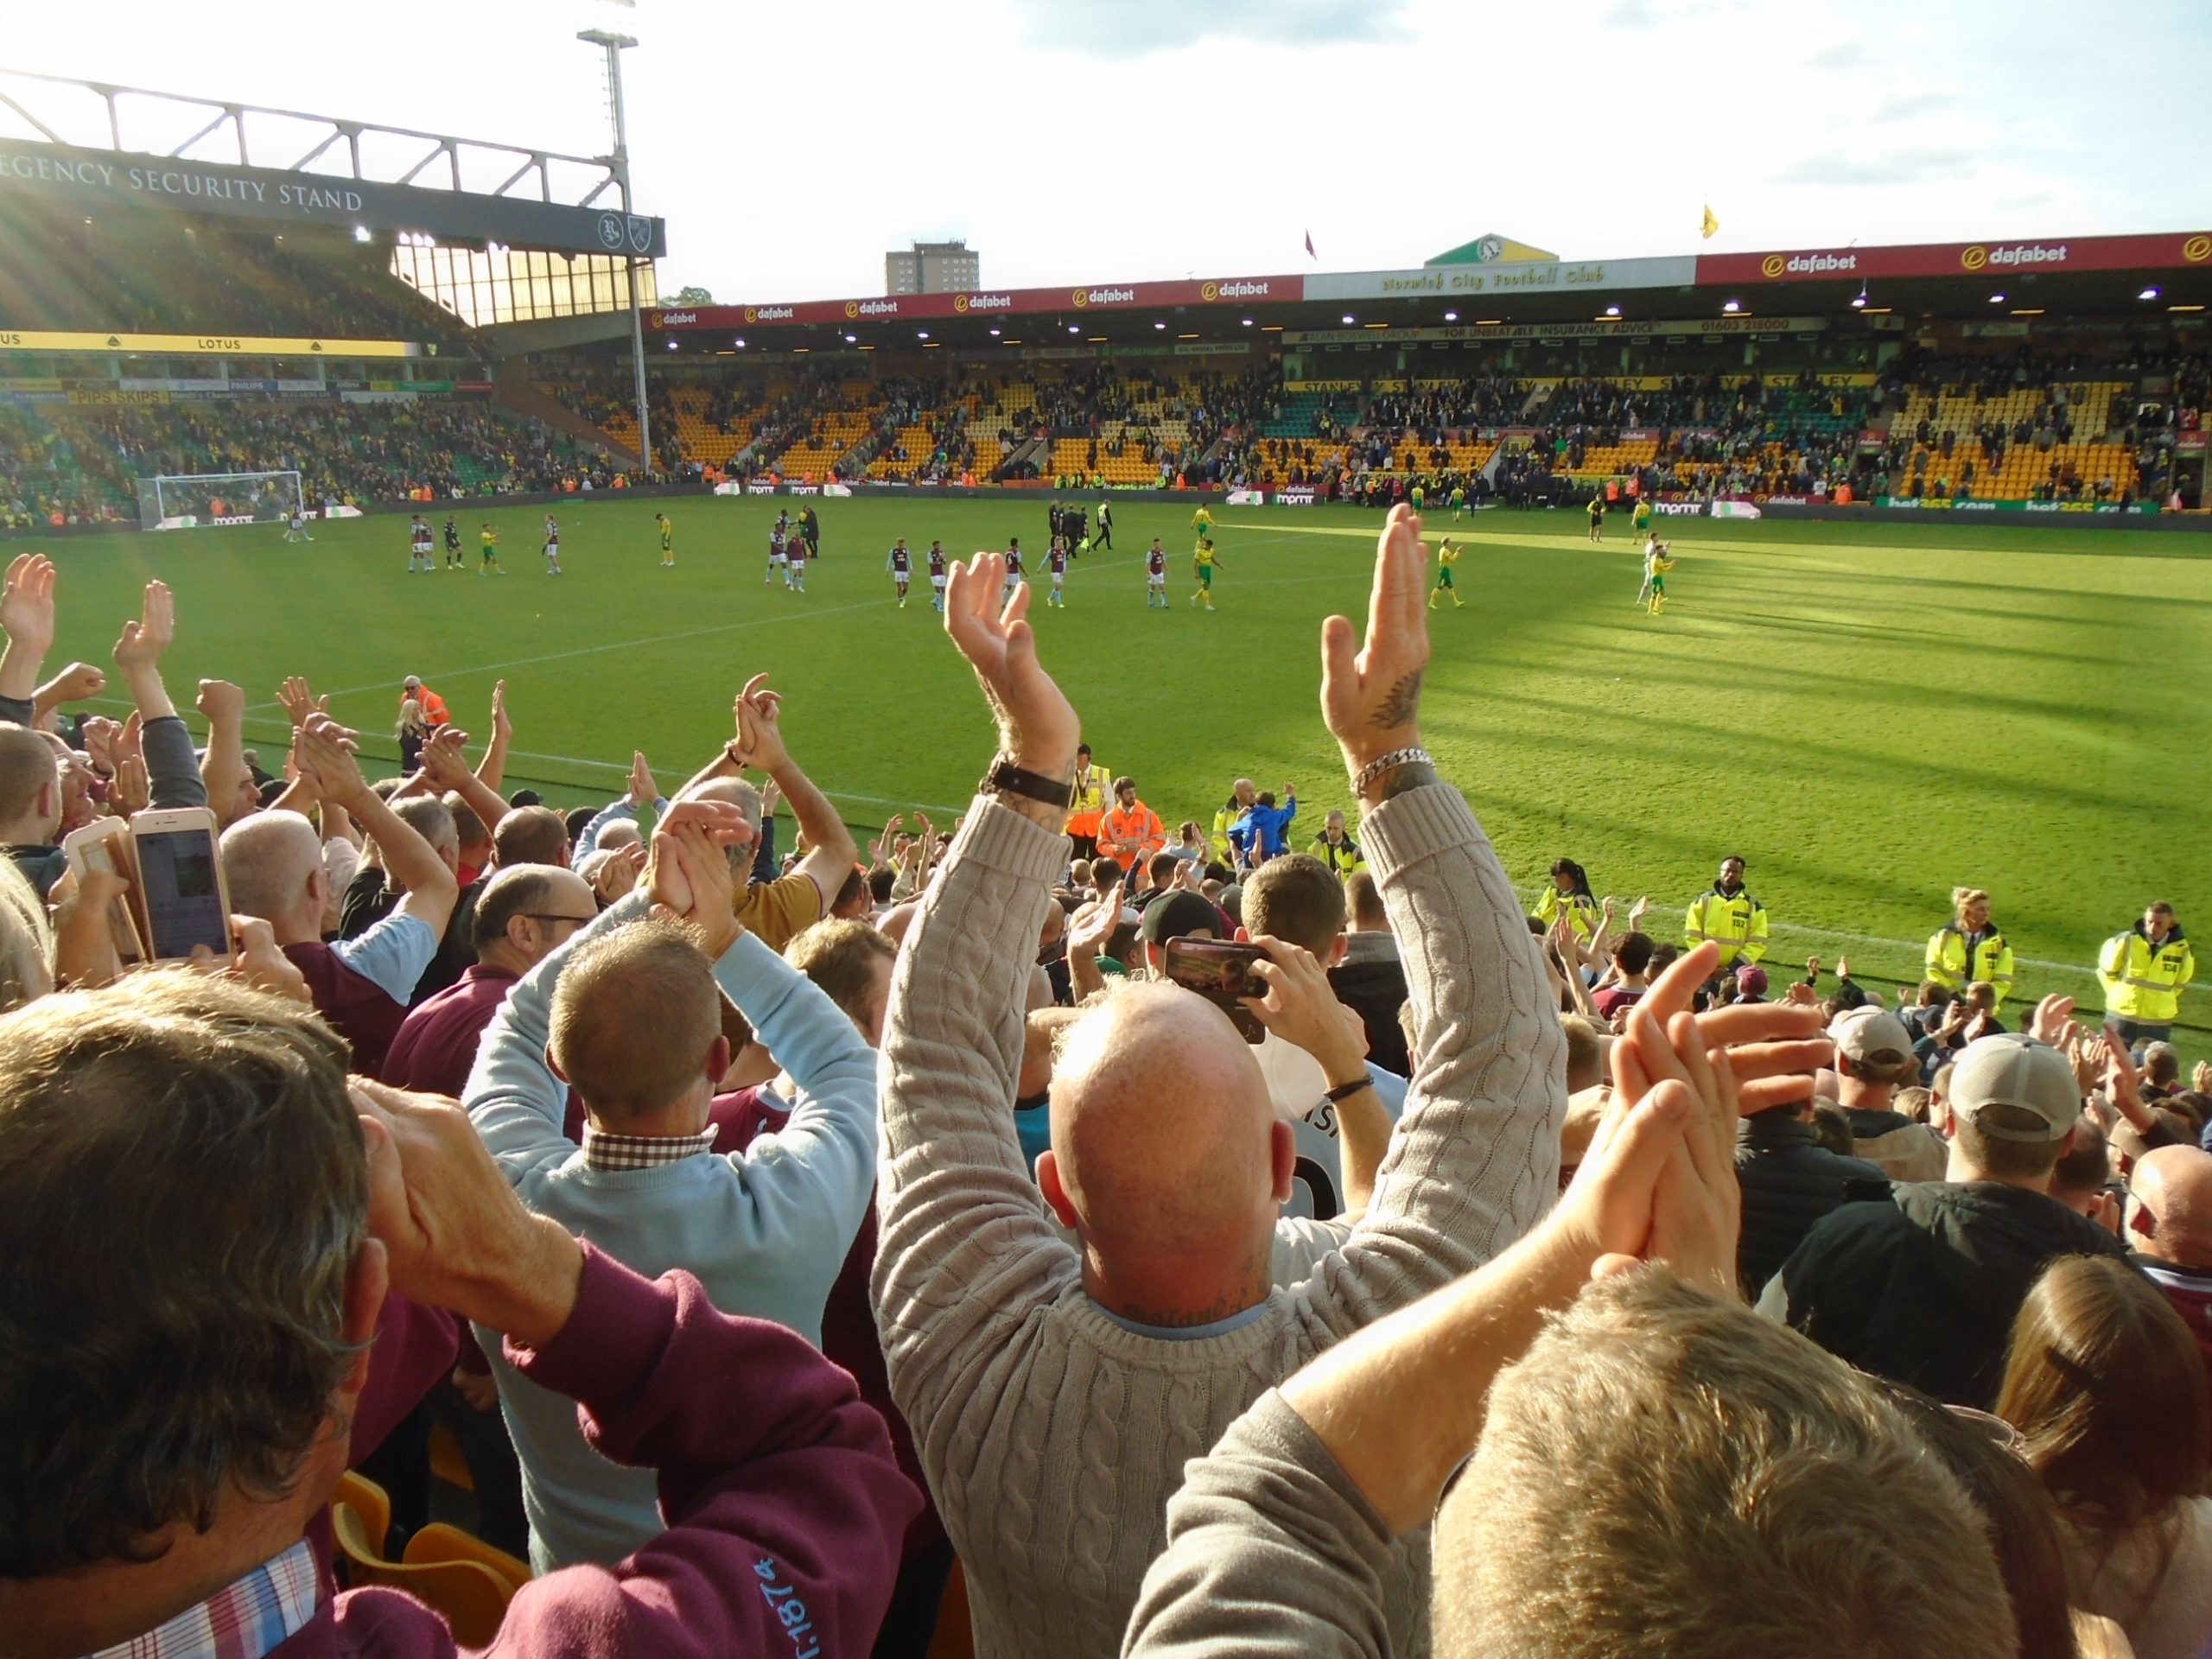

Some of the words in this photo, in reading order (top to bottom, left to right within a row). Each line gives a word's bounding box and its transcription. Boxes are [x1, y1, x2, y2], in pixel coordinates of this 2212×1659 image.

[130, 168, 267, 204] SECURITY
[279, 184, 363, 213] STAND
[1988, 245, 2067, 264] dafabet
[1786, 253, 1857, 273] dafabet
[1452, 273, 1484, 291] City
[1494, 268, 1557, 286] Football
[1566, 265, 1605, 283] Club
[1089, 289, 1134, 303] dafabet
[1219, 283, 1268, 297] dafabet
[859, 301, 898, 315] dafabet
[969, 295, 1011, 309] dafabet
[663, 313, 696, 325] dafabet
[757, 307, 793, 321] dafabet
[1540, 323, 1605, 335] INSURANCE
[1701, 320, 1739, 331] 01603
[1745, 318, 1789, 330] 218000
[0, 334, 21, 346] US
[198, 338, 241, 350] LOTUS
[78, 391, 111, 404] PIPS
[116, 391, 160, 404] SKIPS
[1769, 495, 1807, 505] dafabet
